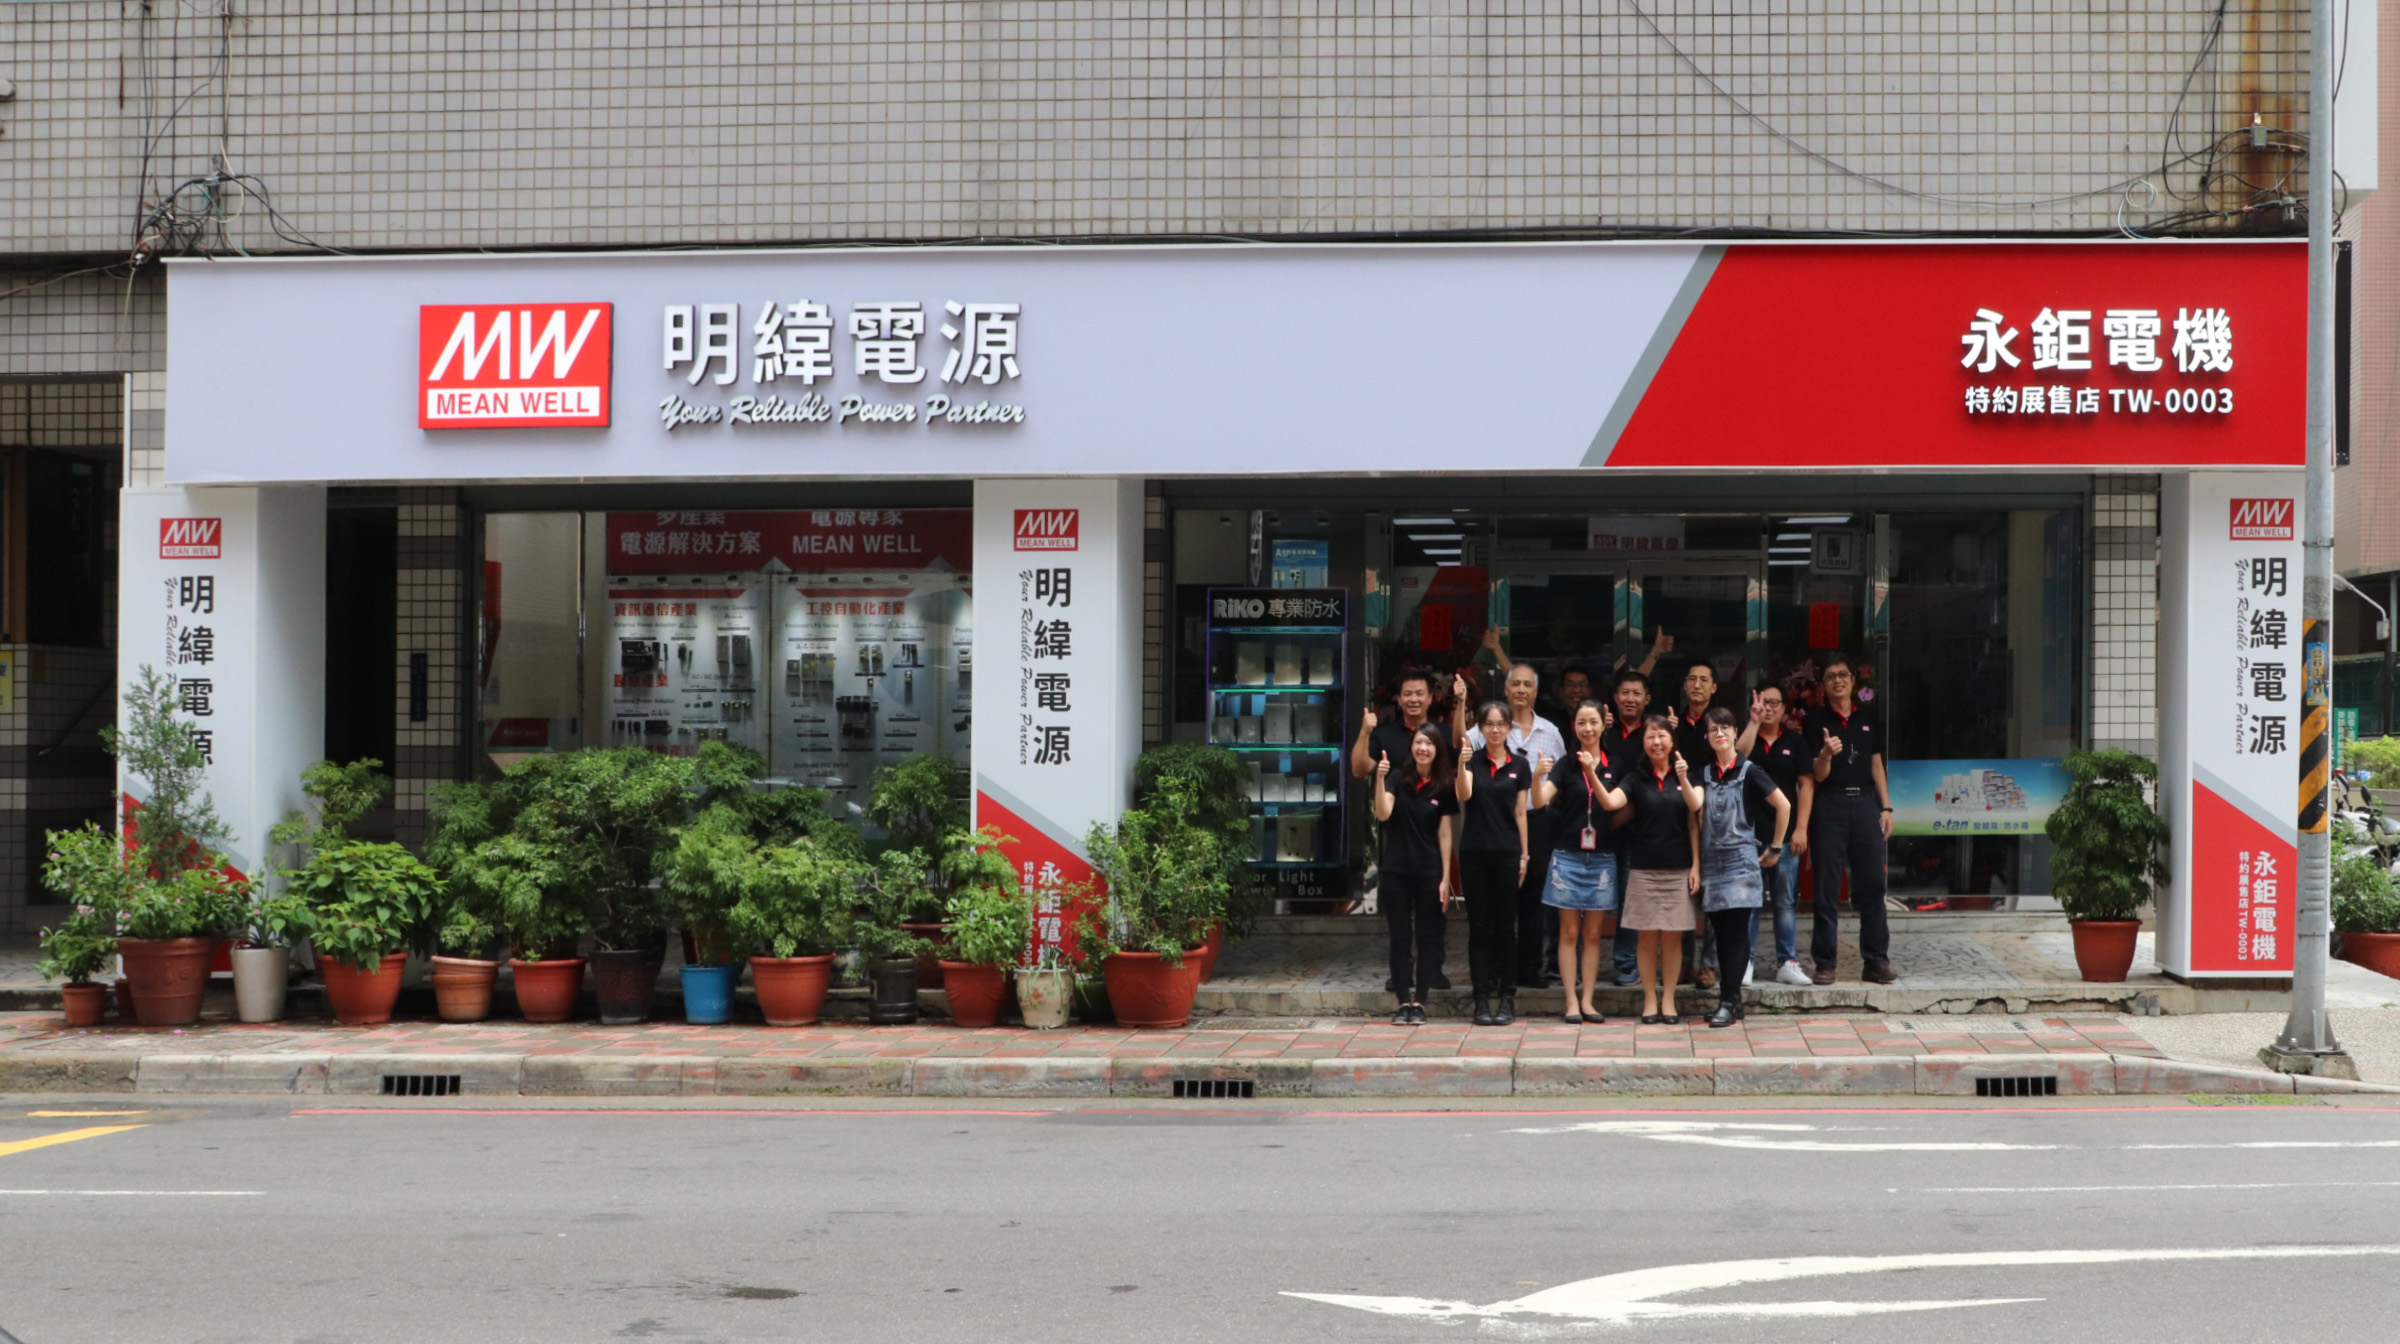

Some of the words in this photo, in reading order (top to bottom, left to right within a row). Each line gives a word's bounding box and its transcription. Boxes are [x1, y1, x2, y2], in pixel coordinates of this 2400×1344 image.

[428, 308, 600, 381] MW
[662, 298, 1021, 386] 明緯電源
[1960, 306, 2234, 373] 永鉅電機
[437, 391, 511, 416] MEAN
[521, 391, 591, 415] WELL
[659, 394, 724, 430] Your
[729, 394, 831, 425] Reliable
[838, 394, 917, 425] Power
[925, 393, 1025, 426] Partner
[1965, 385, 2100, 414] 特約展售店
[2108, 387, 2234, 413] TW-0003
[1018, 511, 1075, 536] MW
[2232, 501, 2291, 525] MW
[163, 520, 218, 544] MW
[620, 531, 761, 555] 電源解決方案
[792, 535, 854, 554] MEAN
[863, 534, 922, 553] WELL
[1019, 539, 1045, 548] MEAN
[1048, 538, 1072, 547] WELL
[2235, 528, 2261, 537] MEAN
[2263, 527, 2288, 536] WELL
[165, 546, 190, 556] MEAN
[192, 546, 216, 556] WELL
[1018, 569, 1033, 603] Your
[2234, 558, 2248, 592] Your
[164, 577, 178, 609] Your
[806, 601, 905, 616] 工控自動化產業
[1213, 598, 1265, 619] RiKO
[1268, 598, 1341, 619] 專業防水
[165, 614, 178, 668] Reliable
[1020, 608, 1033, 662] Reliable
[2236, 597, 2249, 652] Reliable
[1033, 567, 1072, 766] 明緯電源
[2249, 557, 2288, 755] 明緯電源
[2313, 649, 2322, 695] 2610
[1020, 667, 1033, 708] Power
[2236, 656, 2248, 697] Power
[1019, 713, 1033, 766] Partner
[2235, 702, 2248, 755] Partner
[1278, 870, 1315, 885] Light
[1297, 885, 1324, 896] Box
[2252, 851, 2277, 960] 永鉅電機
[2238, 911, 2248, 960] TW-0003
